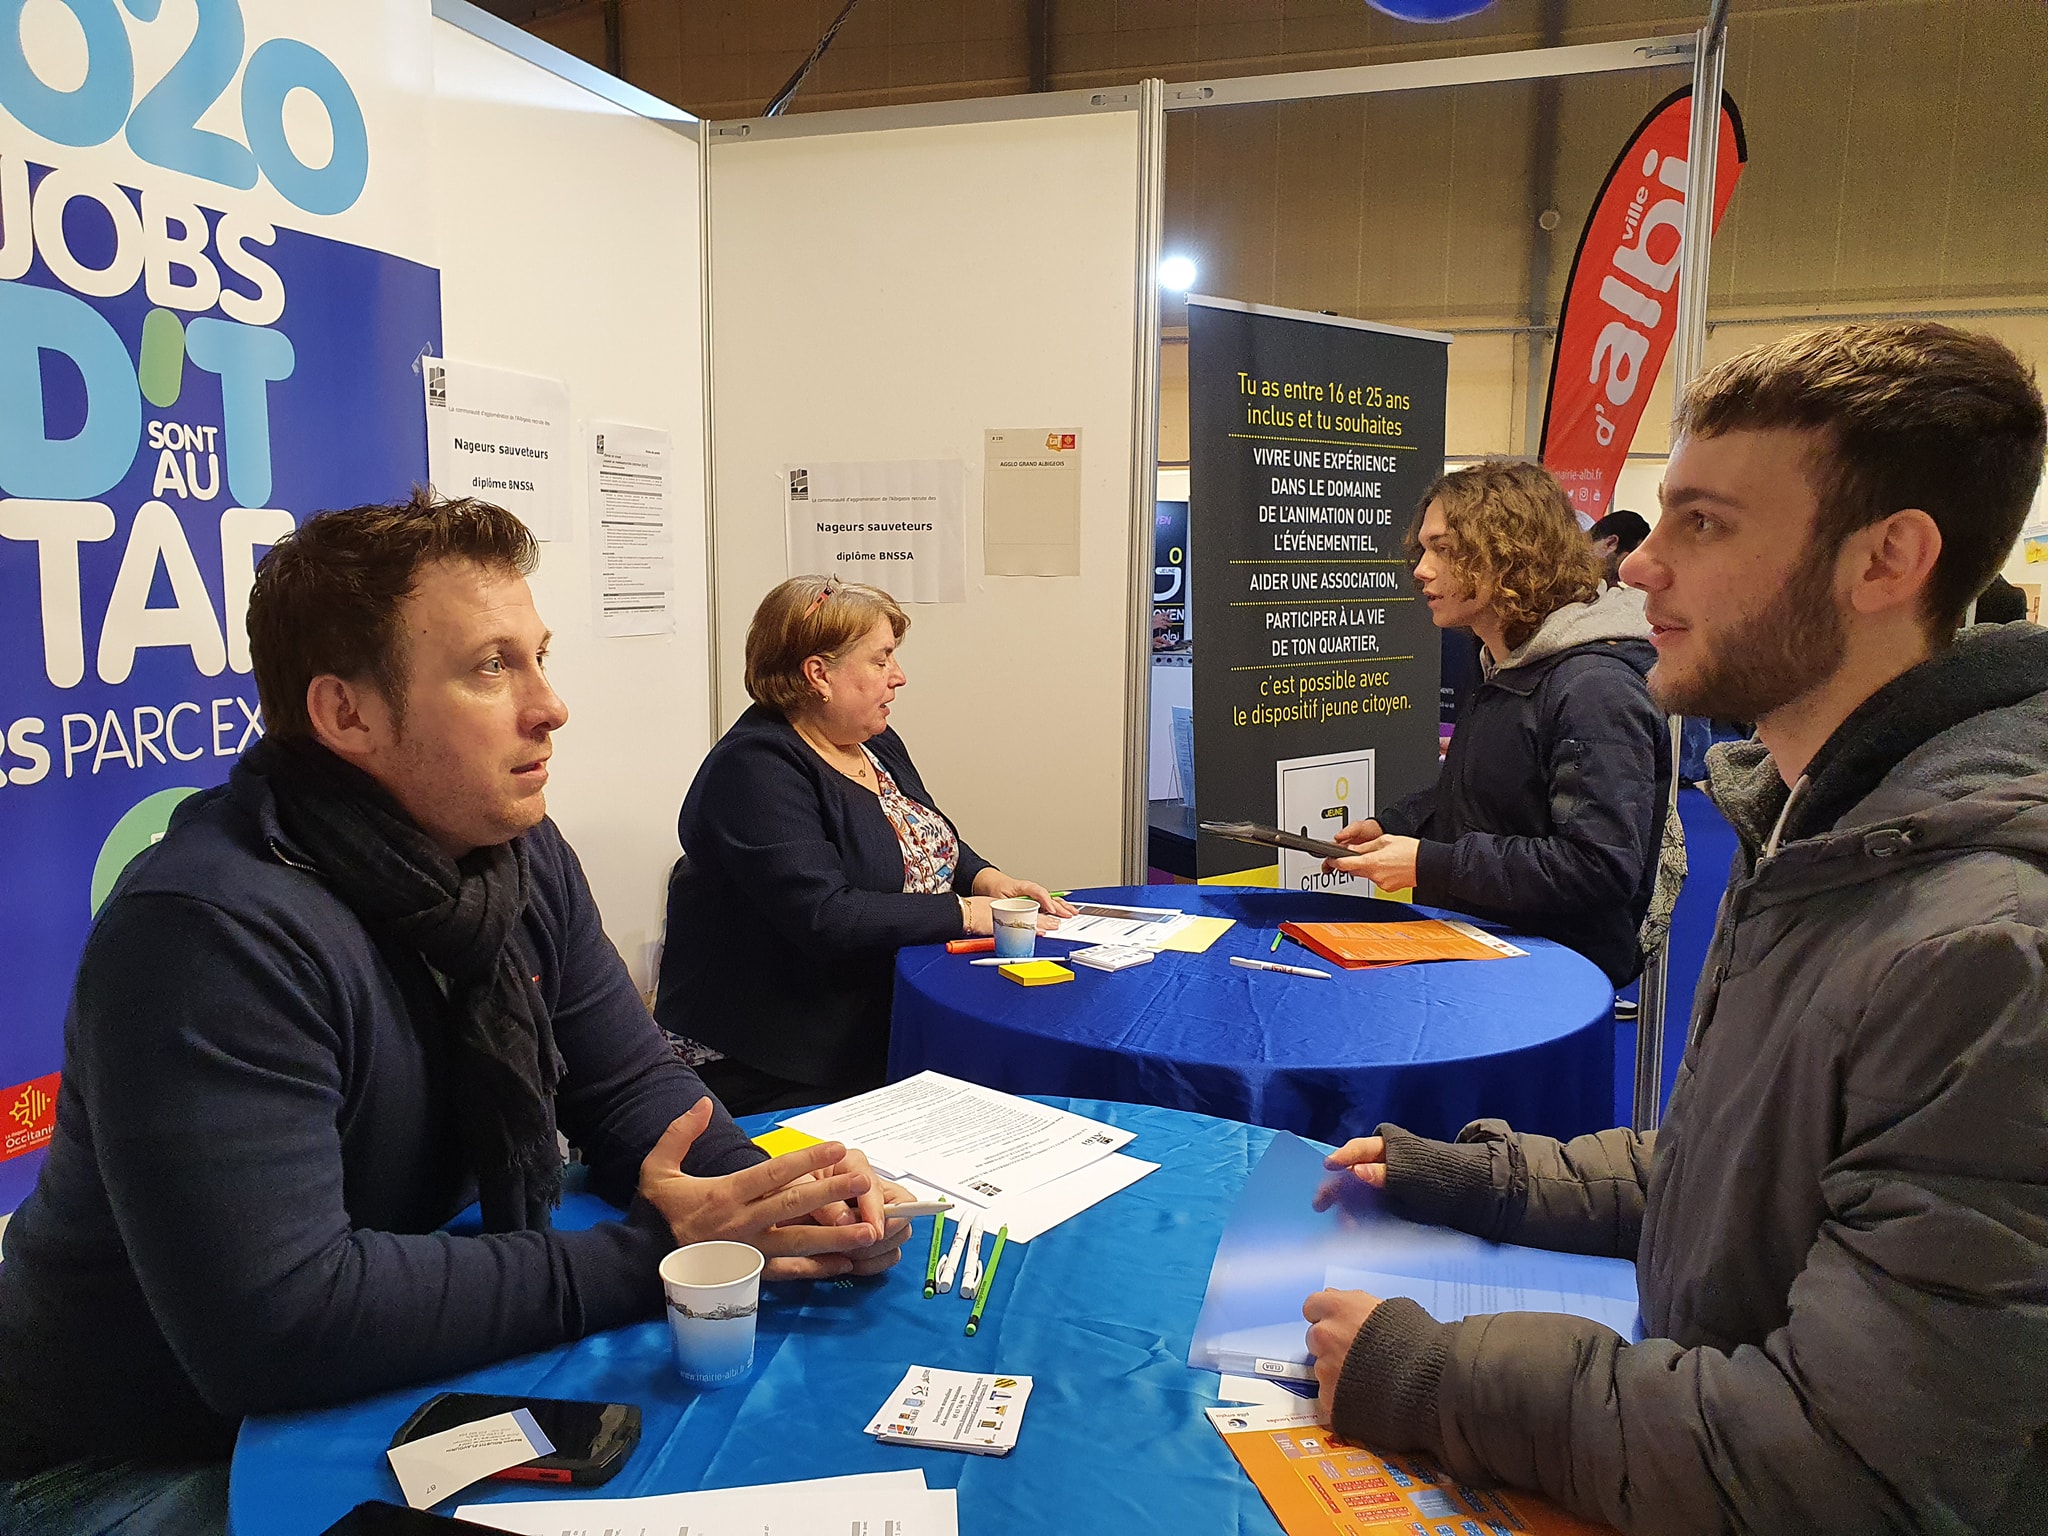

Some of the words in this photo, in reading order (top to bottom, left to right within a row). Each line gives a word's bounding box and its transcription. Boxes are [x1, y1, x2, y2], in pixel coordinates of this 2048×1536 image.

[1622, 186, 1648, 240] ville
[1238, 372, 1257, 396] Tu
[1261, 379, 1279, 398] as
[1284, 381, 1324, 401] entre
[1328, 383, 1344, 403] 16
[1348, 387, 1362, 404] et
[1366, 386, 1382, 406] 25
[1386, 392, 1410, 410] ans
[1247, 404, 1294, 427] inclus
[1298, 410, 1313, 429] et
[1317, 412, 1331, 430] tu
[1335, 414, 1402, 436] souhaites
[148, 421, 218, 453] SONT
[454, 438, 495, 454] Nageurs
[499, 445, 548, 459] sauveteurs
[1254, 448, 1291, 467] VIVRE
[1294, 451, 1320, 468] UNE
[1324, 450, 1396, 472] EXPÉRIENCE
[153, 450, 220, 501] AU
[472, 476, 507, 489] diplôme
[509, 480, 534, 491] BNSSA
[1555, 468, 1603, 480] airie-albi.fr
[1271, 478, 1306, 496] DANS
[1309, 480, 1324, 496] LE
[1327, 480, 1382, 498] DOMAINE
[1259, 506, 1276, 522] DE
[1279, 506, 1354, 524] L'ANIMATION
[1357, 508, 1373, 524] OU
[1376, 509, 1392, 525] DE
[816, 522, 865, 534] Nageurs
[867, 521, 933, 532] sauveteurs
[1274, 530, 1378, 553] L'ÉVÉNEMENTIEL,
[836, 550, 876, 562] diplôme
[879, 551, 914, 560] BNSSA
[1250, 572, 1288, 591] AIDER
[1292, 573, 1318, 590] UNE
[1320, 572, 1398, 590] ASSOCIATION,
[1266, 609, 1336, 629] PARTICIPER
[1339, 606, 1348, 627] À
[1350, 610, 1365, 626] LA
[1367, 608, 1385, 625] VIE
[1272, 639, 1288, 656] DE
[1291, 638, 1316, 656] TON
[1319, 635, 1379, 654] QUARTIER,
[1260, 675, 1295, 697] c'est
[1300, 670, 1356, 698] possible
[1359, 670, 1390, 688] avec
[1233, 706, 1247, 727] le
[1252, 698, 1318, 728] dispositif
[1320, 700, 1358, 722] jeune
[1362, 694, 1412, 720] citoyen.
[62, 702, 203, 778] PARC
[1325, 808, 1344, 817] JEUNE
[6, 1124, 55, 1148] Occitani
